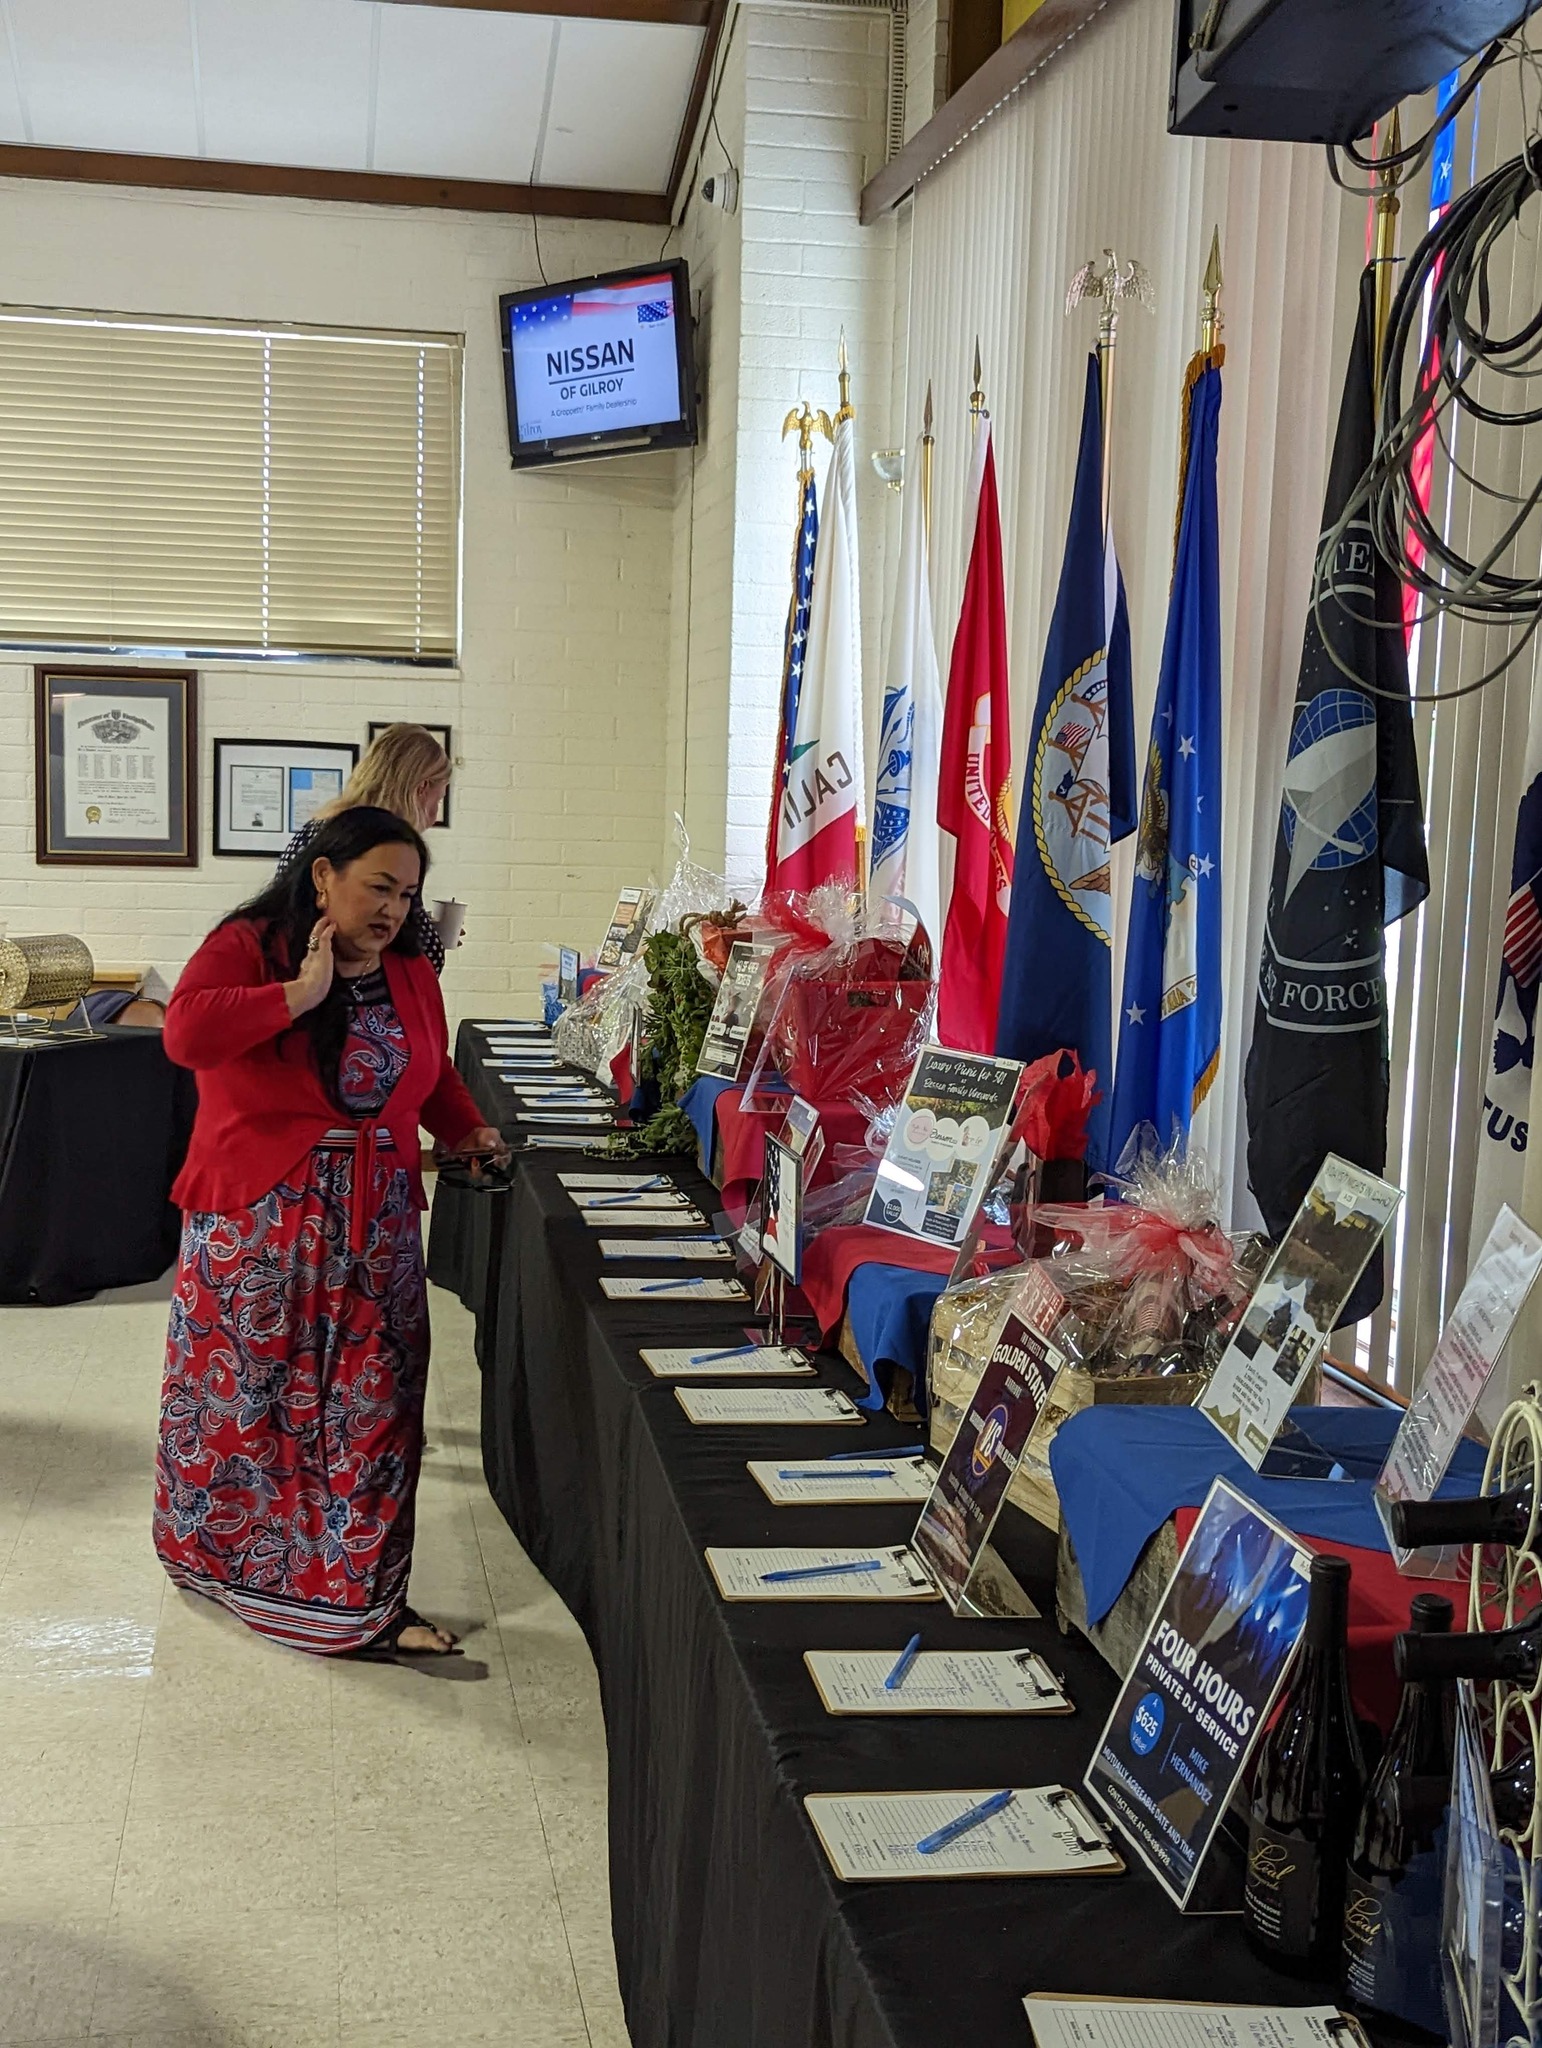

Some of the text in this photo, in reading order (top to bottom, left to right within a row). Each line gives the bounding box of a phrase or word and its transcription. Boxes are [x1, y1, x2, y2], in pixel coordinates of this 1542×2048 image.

[547, 338, 635, 377] NISSAN
[560, 378, 624, 400] OF GILROY
[586, 403, 605, 413] Family
[606, 398, 637, 410] Dealership
[1280, 976, 1380, 1012] FORCE
[946, 1083, 968, 1097] Family
[954, 1061, 977, 1078] Picnic
[977, 1066, 992, 1082] for
[993, 1344, 1031, 1376] GOLDEN
[1024, 1362, 1048, 1411] STATE
[980, 1418, 1003, 1457] VS
[1153, 1620, 1256, 1737] FOUR HOURS
[1145, 1652, 1240, 1760] PRIVATE DJ SERVICE
[1152, 1698, 1158, 1706] A
[1135, 1706, 1159, 1738] $625
[1170, 1753, 1214, 1806] HERNANDEZ
[1188, 1747, 1210, 1775] MIKE
[1102, 1745, 1196, 1863] MUTUALLY AGREEABLE DATE AND TIME
[1107, 1784, 1127, 1812] CONTACT
[1125, 1806, 1139, 1825] MIKE
[1136, 1819, 1145, 1832] AT
[1249, 1837, 1296, 1882] Leal
